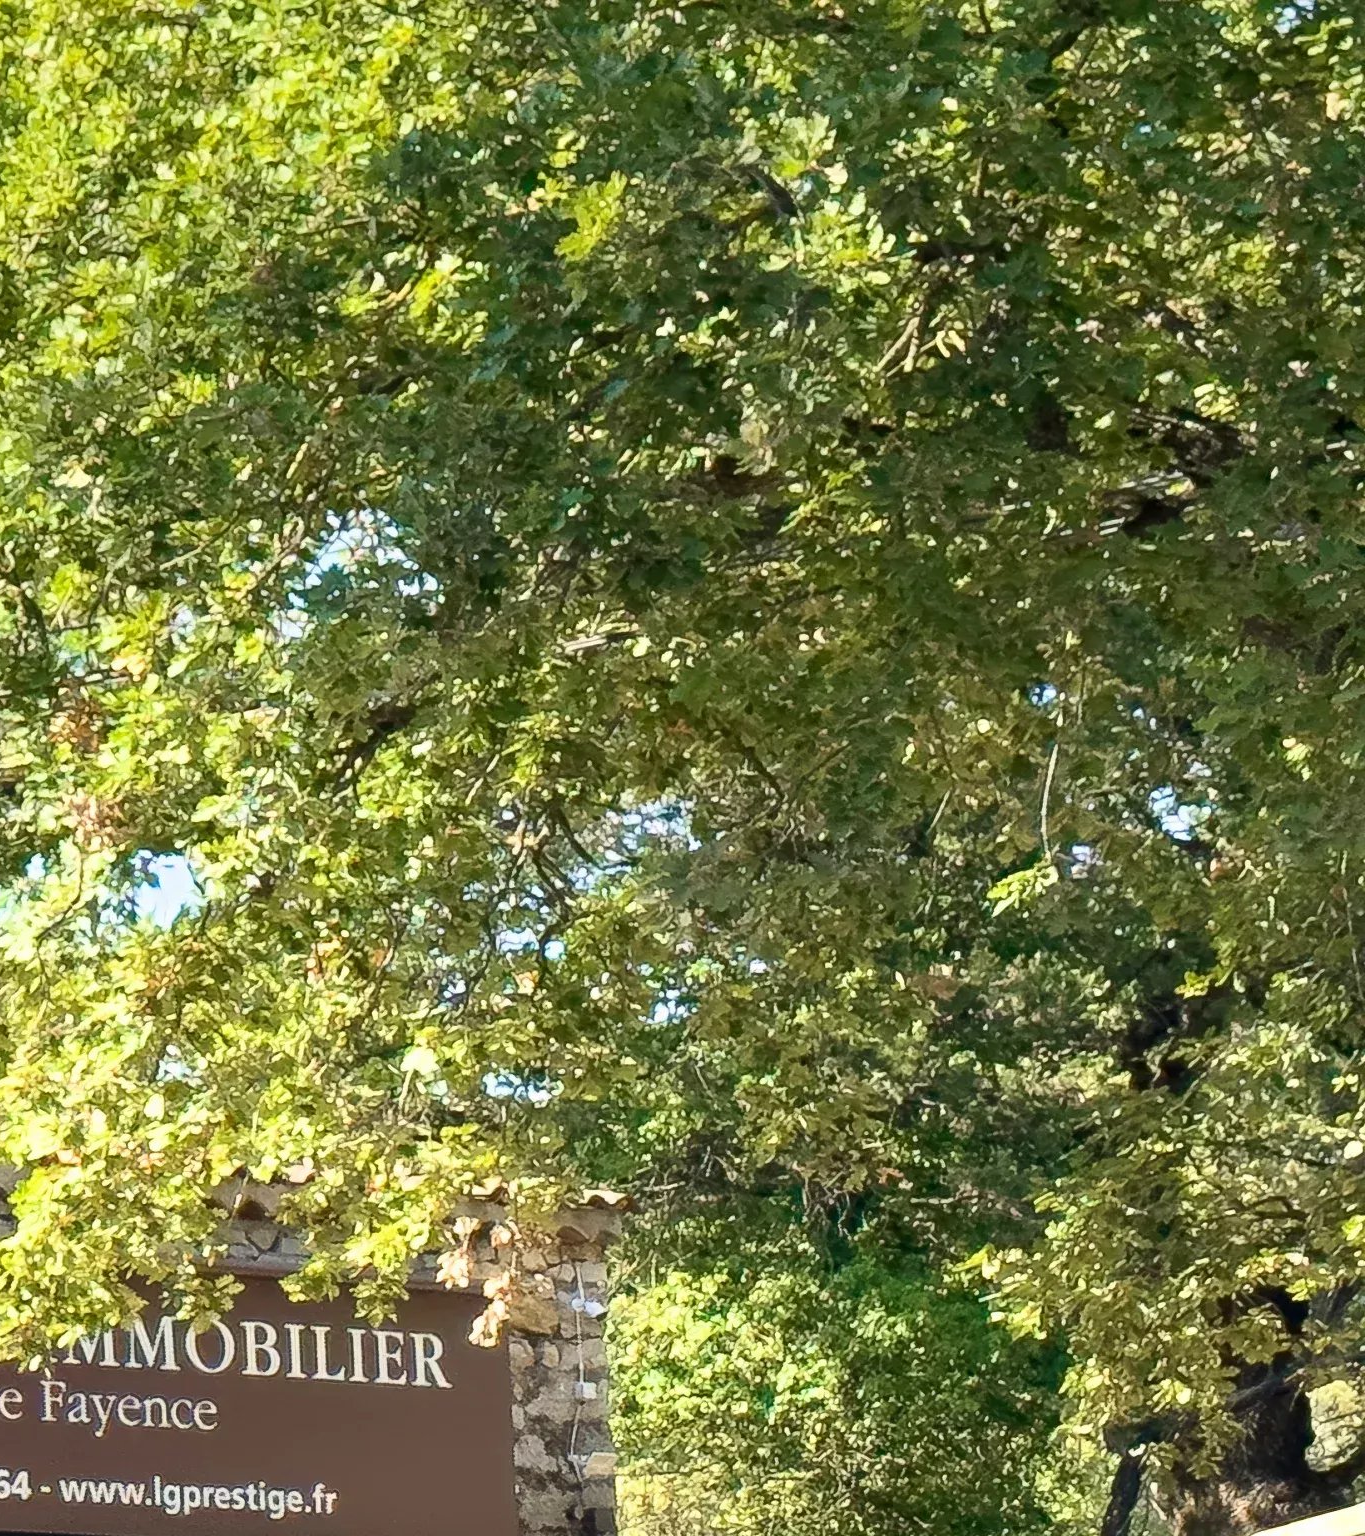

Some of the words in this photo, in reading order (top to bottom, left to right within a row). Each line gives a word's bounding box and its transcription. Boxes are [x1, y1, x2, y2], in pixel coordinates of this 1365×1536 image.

[47, 1312, 453, 1389] MMOBILIER
[41, 1378, 218, 1438] Fayence
[58, 1475, 339, 1521] www.lgprestige.fr
